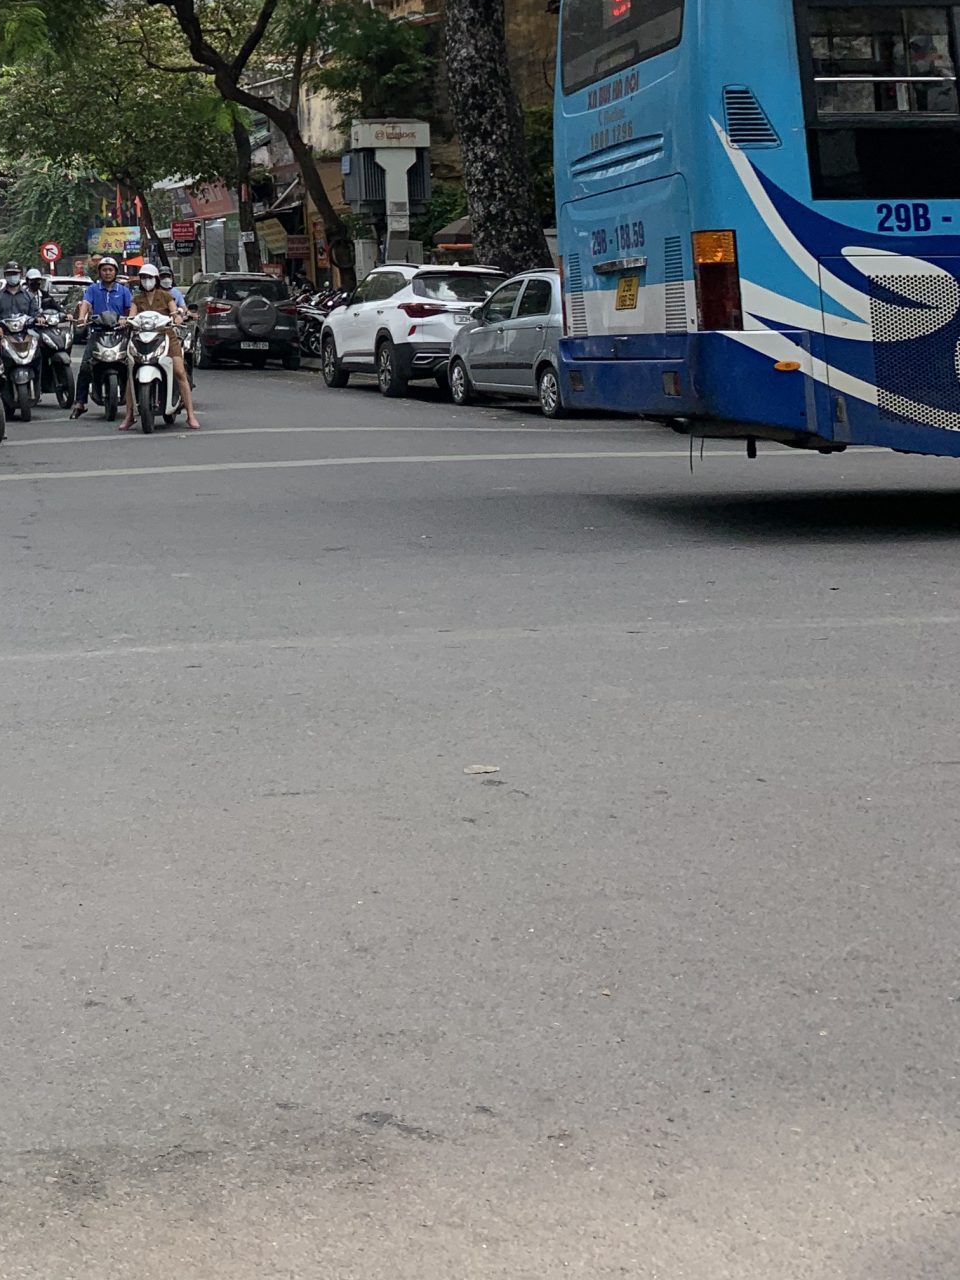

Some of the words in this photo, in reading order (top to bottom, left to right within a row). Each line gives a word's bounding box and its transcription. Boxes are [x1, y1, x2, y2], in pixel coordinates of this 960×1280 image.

[877, 203, 932, 232] 29B
[591, 228, 608, 257] 29B
[615, 220, 645, 252] 188.59
